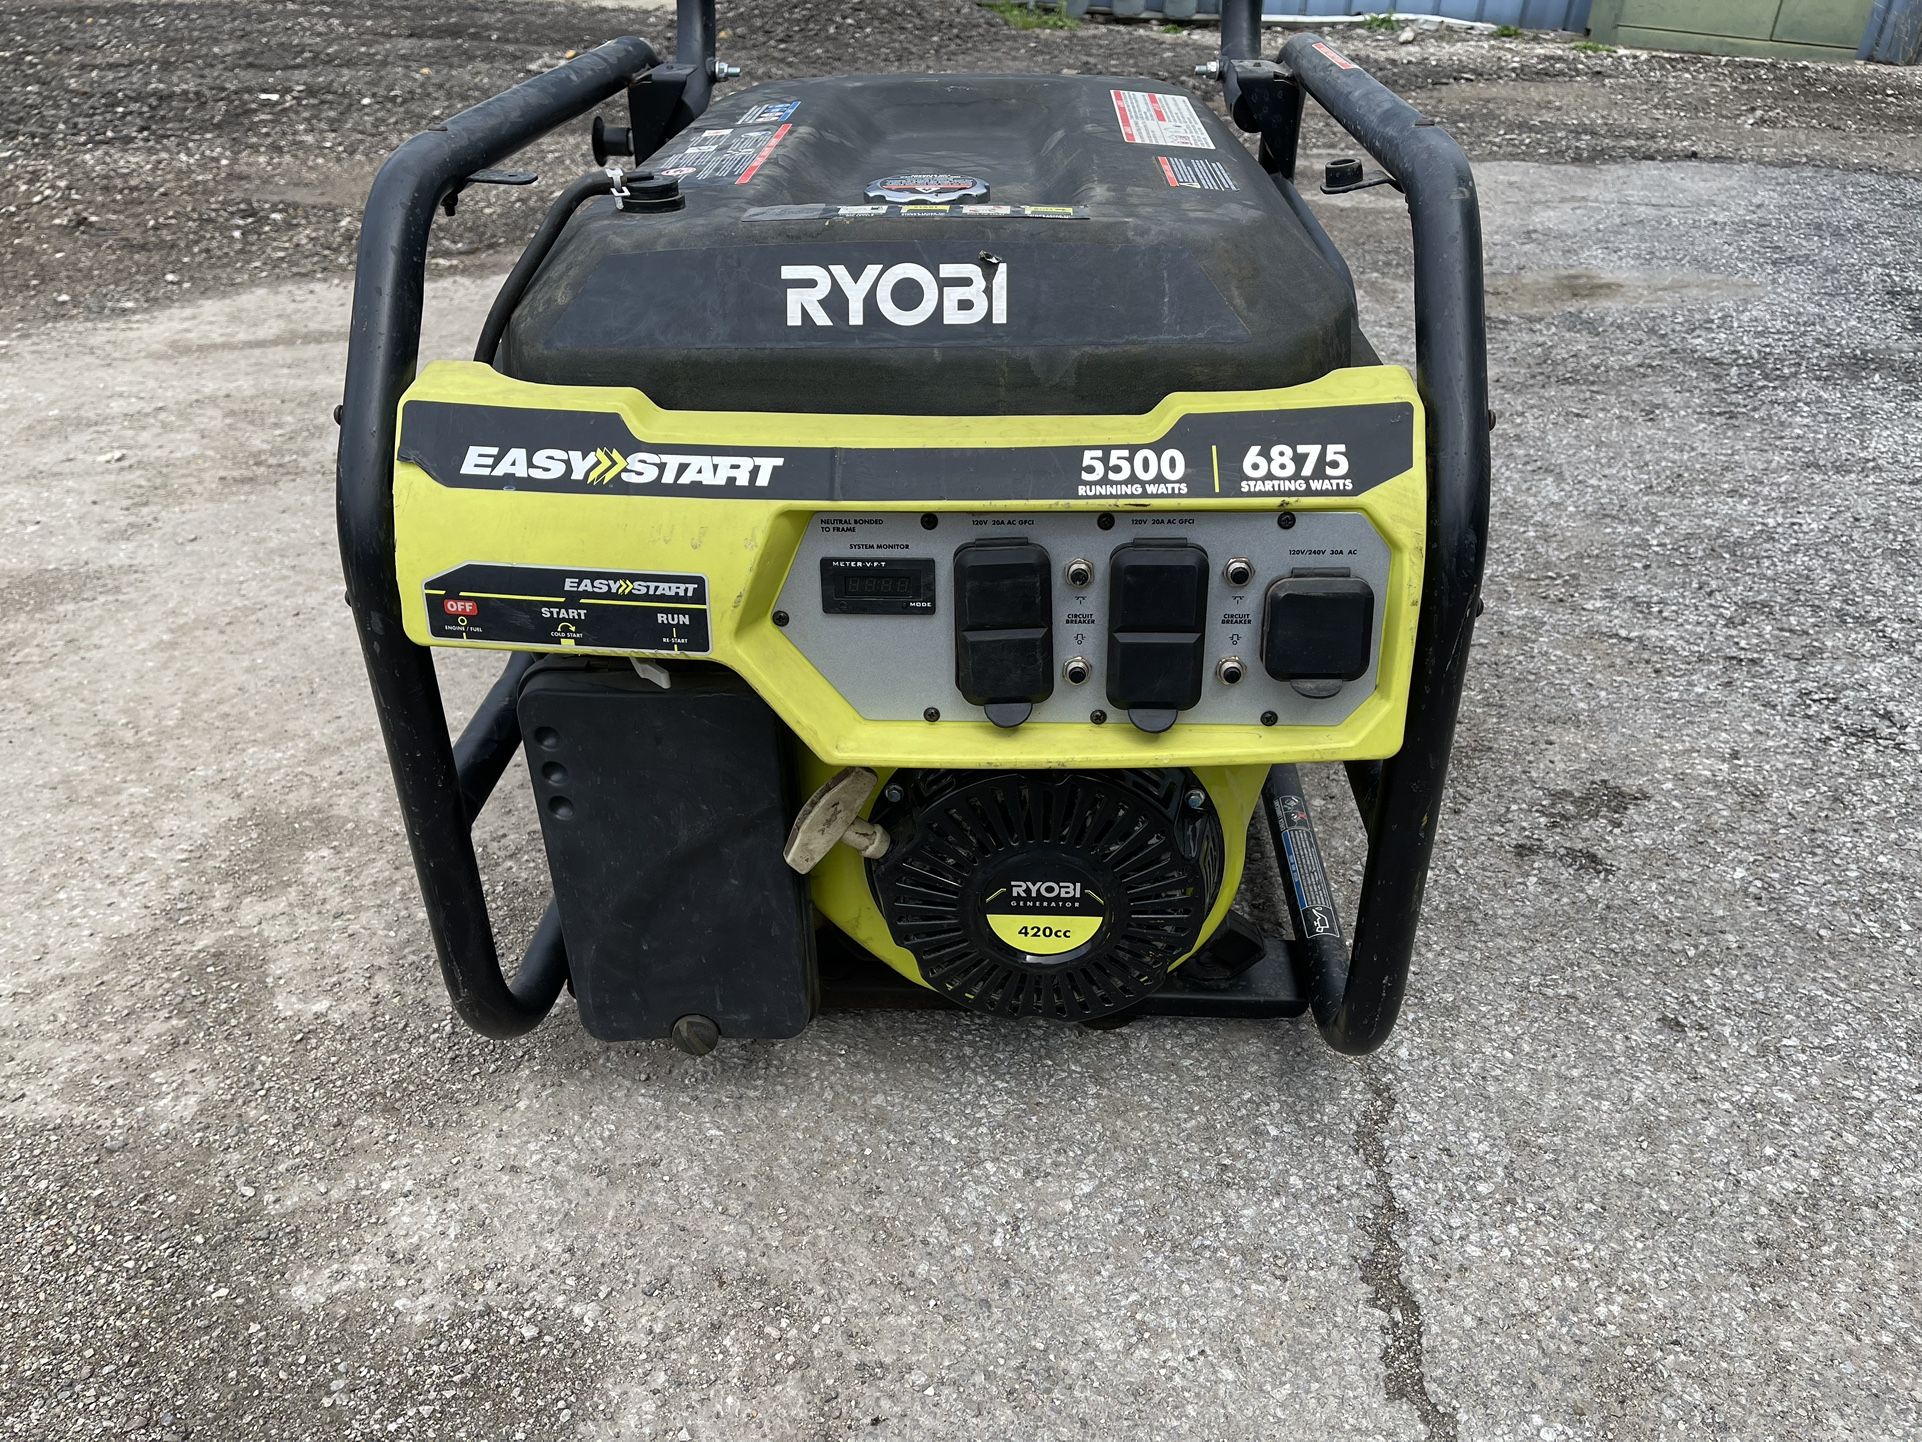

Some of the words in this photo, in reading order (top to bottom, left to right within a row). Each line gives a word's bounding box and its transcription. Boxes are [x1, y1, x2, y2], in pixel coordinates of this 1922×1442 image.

[780, 262, 1008, 326] RYOBI
[459, 445, 598, 481] EASY
[621, 452, 784, 487] START
[1080, 448, 1187, 481] 5500
[1242, 443, 1350, 478] 6875
[1077, 484, 1143, 497] RUNNING
[1145, 482, 1188, 496] WATTS
[1240, 480, 1306, 493] STARTING
[1308, 478, 1353, 491] WATTS
[564, 578, 621, 593] EASY
[631, 582, 698, 597] START
[447, 601, 473, 612] OFF
[541, 607, 587, 620] START
[657, 613, 690, 625] RUN
[1010, 881, 1081, 898] RYOBI
[1018, 926, 1071, 938] 420cc
